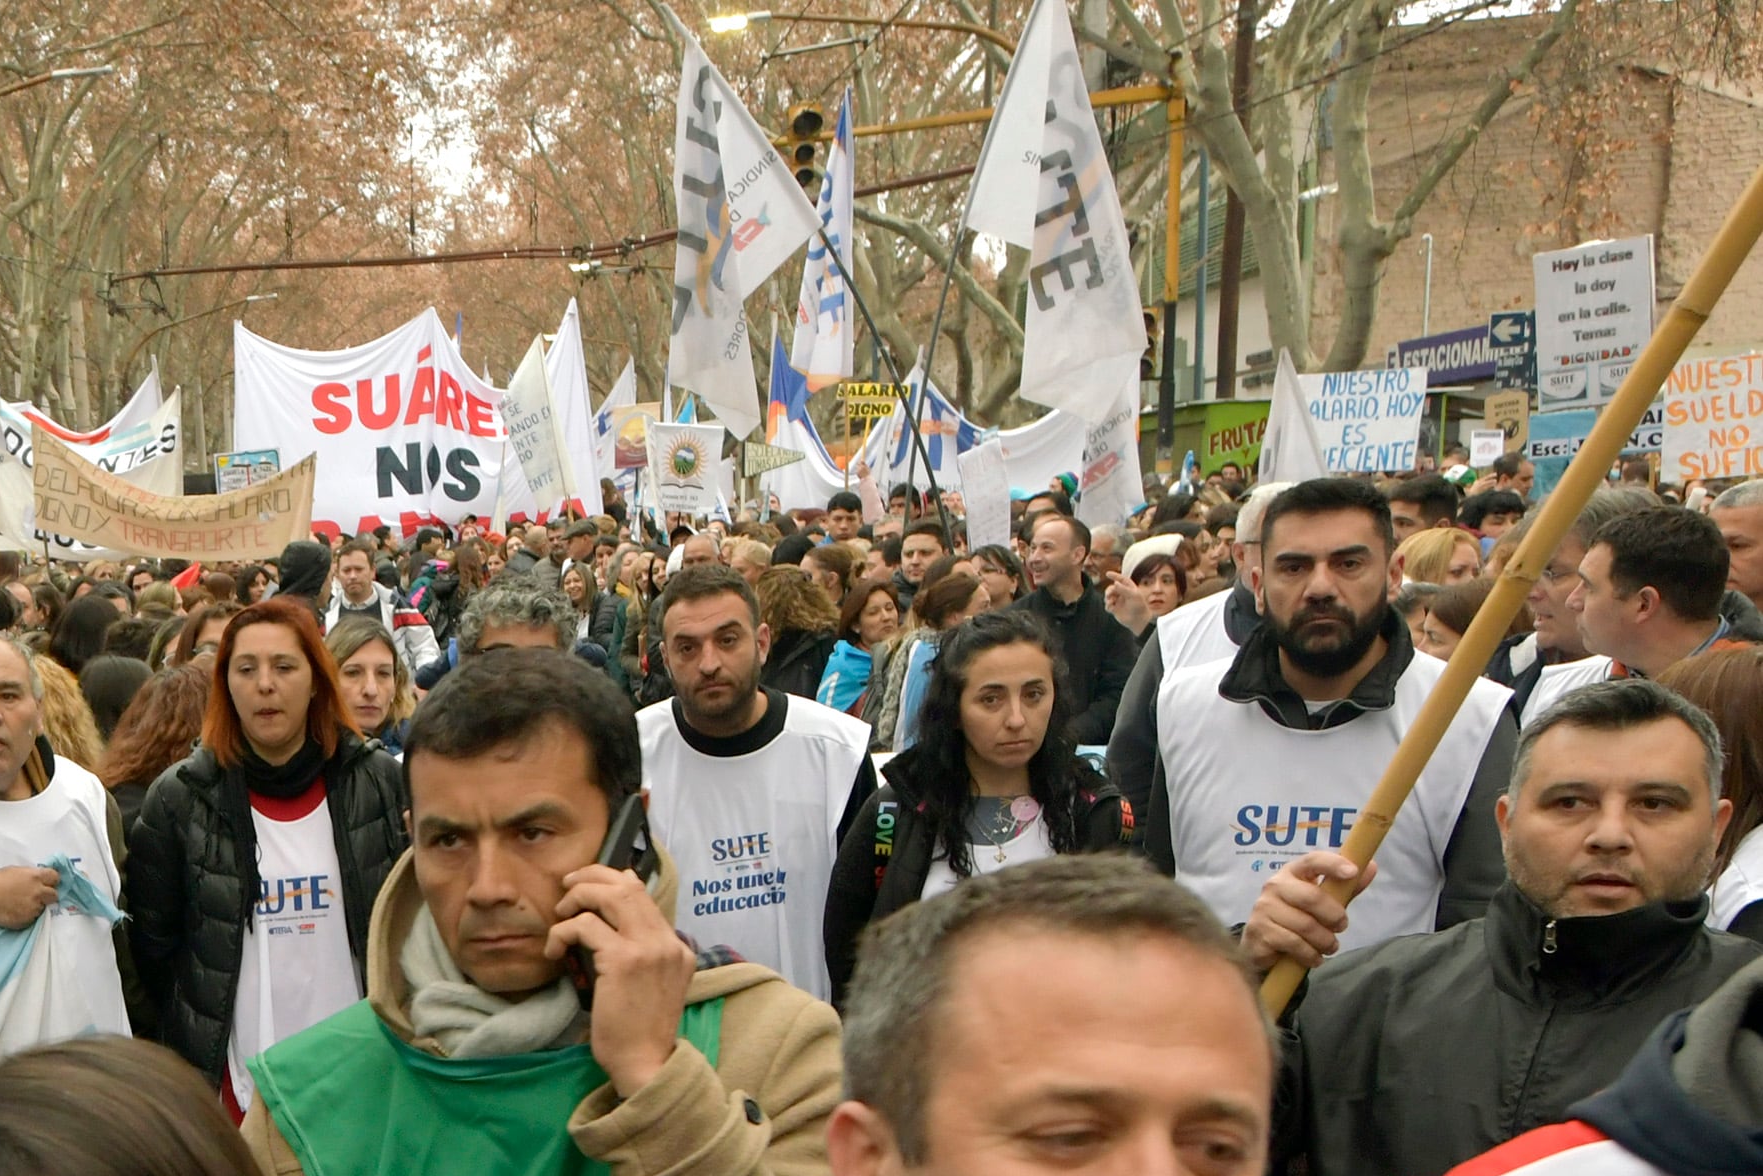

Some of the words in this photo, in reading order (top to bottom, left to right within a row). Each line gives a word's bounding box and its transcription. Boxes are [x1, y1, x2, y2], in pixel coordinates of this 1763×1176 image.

[1552, 258, 1579, 272] Hoy
[1583, 255, 1595, 267] la
[1599, 250, 1633, 265] clase
[1575, 282, 1586, 294] la
[1591, 279, 1616, 291] doy
[1558, 311, 1575, 323] en
[1579, 308, 1591, 320] la
[1595, 303, 1631, 317] calle.
[1573, 327, 1616, 342] Tema:
[1403, 336, 1529, 373] ESTACIONAM
[1322, 367, 1410, 397] NUESTRO
[1610, 367, 1629, 378] SUT
[1668, 353, 1763, 396] NUEST
[312, 344, 509, 437] SUÁRE
[1309, 396, 1380, 420] ALARIO,
[1386, 392, 1424, 418] HOY
[1342, 423, 1368, 446] ES
[1709, 424, 1750, 449] NO
[1323, 440, 1416, 472] FICIENTE
[1532, 442, 1568, 457] Esc:
[874, 801, 898, 856] LOVE
[1234, 804, 1358, 848] SUTE
[711, 831, 771, 861] SUTE
[692, 878, 732, 897] Nos
[736, 871, 774, 890] une
